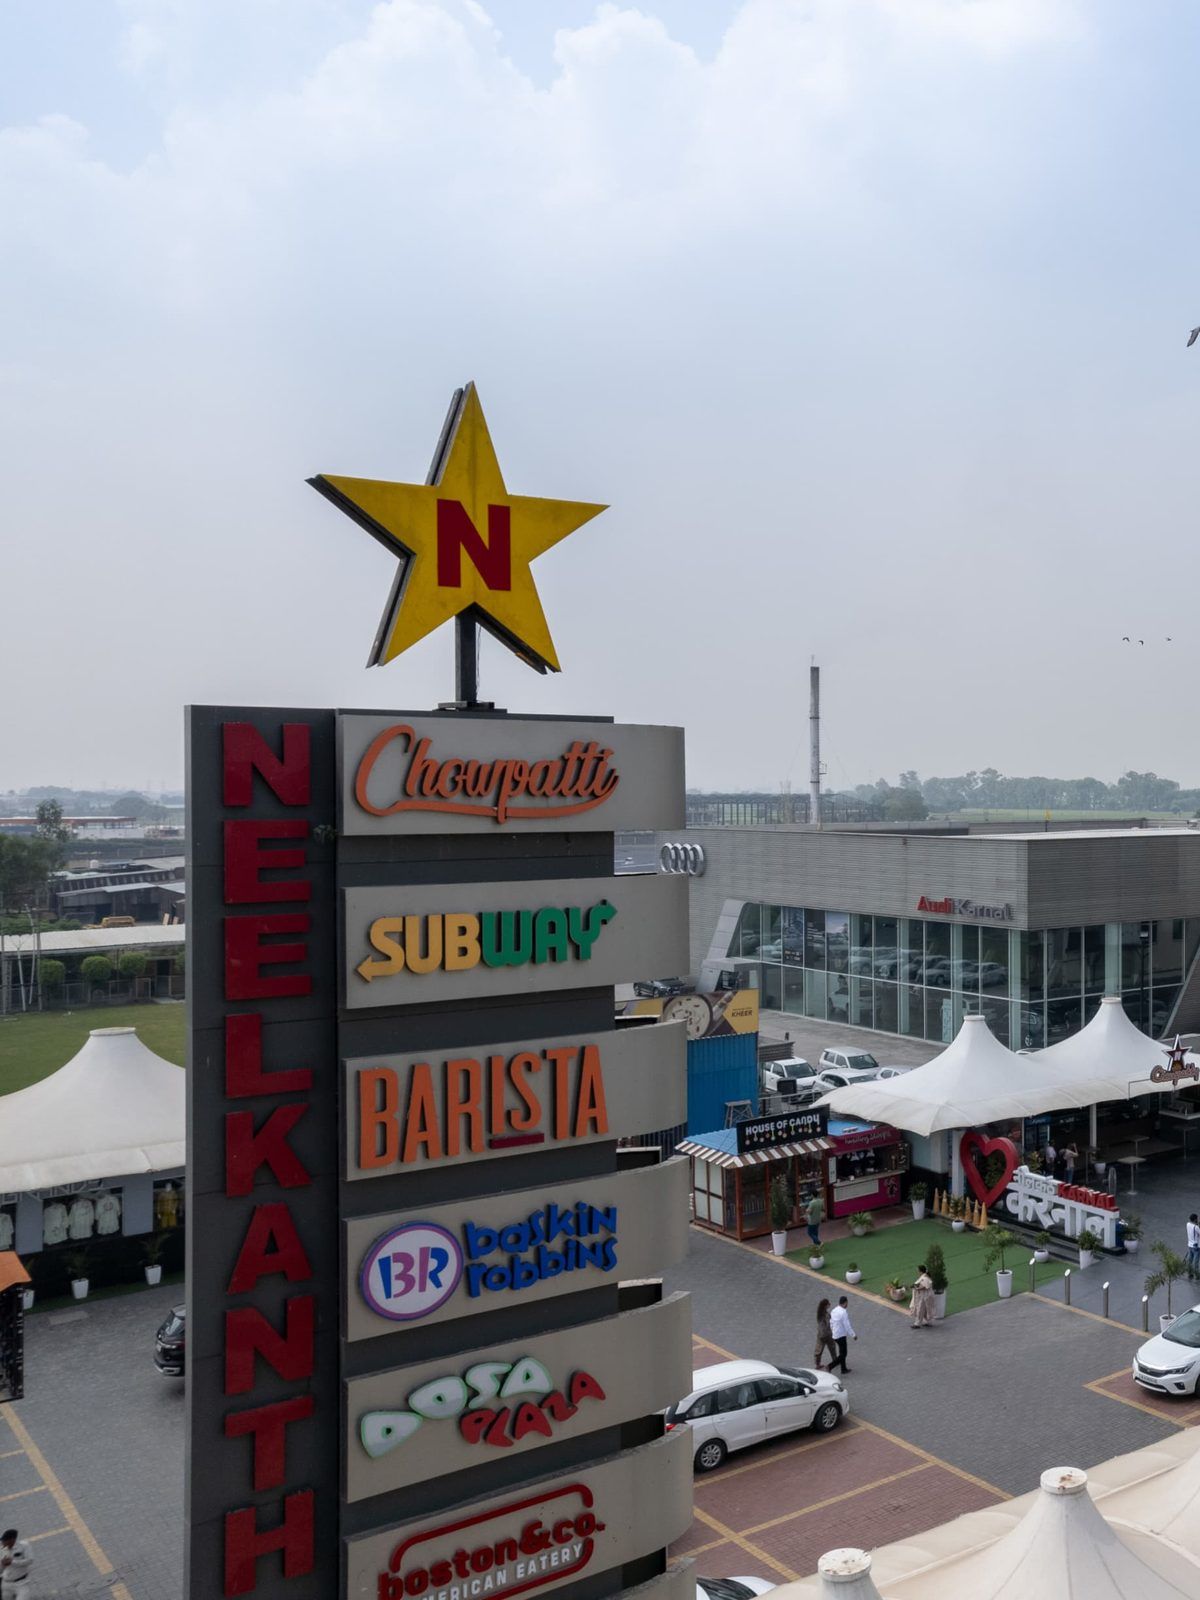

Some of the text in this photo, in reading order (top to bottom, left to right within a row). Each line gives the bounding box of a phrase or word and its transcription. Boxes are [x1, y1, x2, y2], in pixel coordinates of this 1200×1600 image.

[436, 498, 511, 591] N
[357, 899, 618, 983] SUBWAY
[917, 896, 1013, 920] Audi Karnal
[357, 1044, 608, 1169] BARISTA
[745, 1114, 820, 1136] HOUSE OF CANDY
[222, 722, 314, 1598] NEELKANTH
[1006, 1182, 1120, 1248] करनाल
[1058, 1182, 1120, 1212] KARNAL
[378, 1246, 449, 1299] BR
[459, 1371, 606, 1447] PLAZA
[516, 1543, 583, 1579] EATERY
